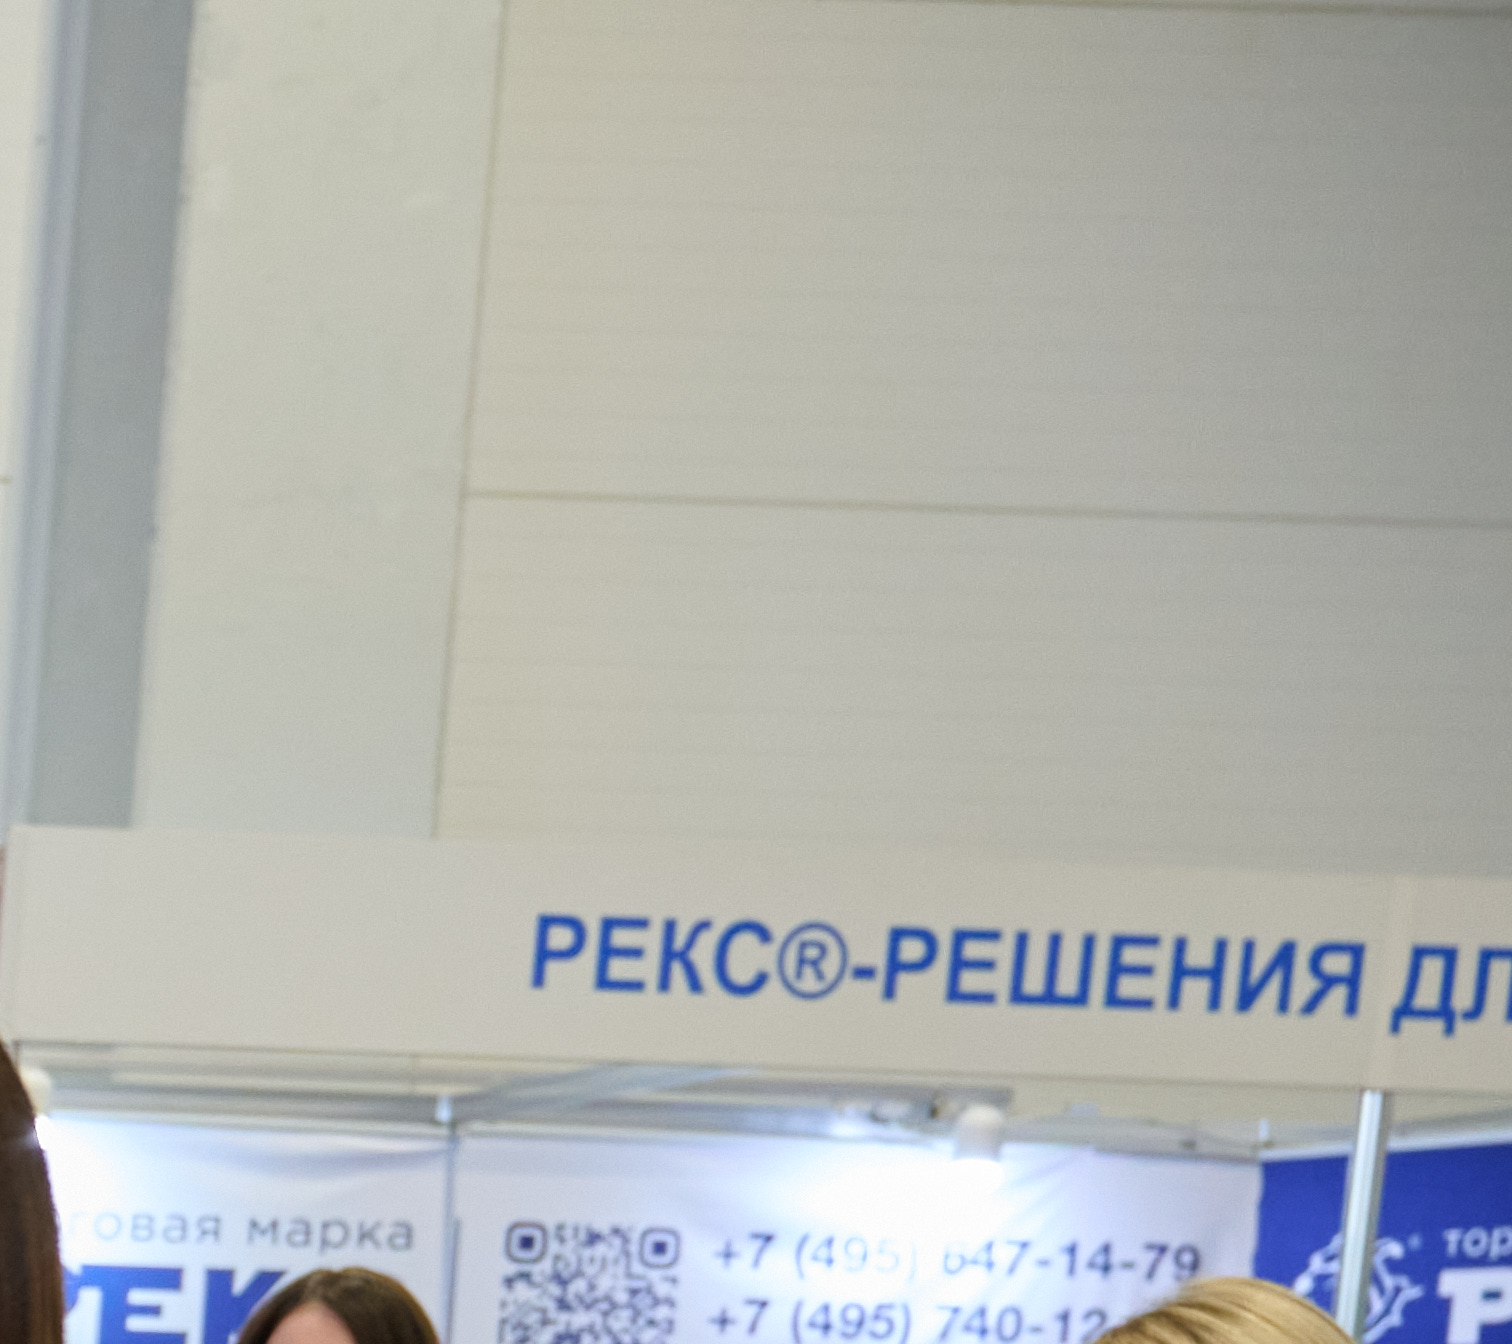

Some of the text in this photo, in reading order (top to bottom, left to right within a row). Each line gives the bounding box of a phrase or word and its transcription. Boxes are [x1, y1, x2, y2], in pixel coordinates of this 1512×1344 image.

[248, 1215, 414, 1255] марка
[713, 1233, 774, 1269] +7
[708, 1299, 768, 1336] +7
